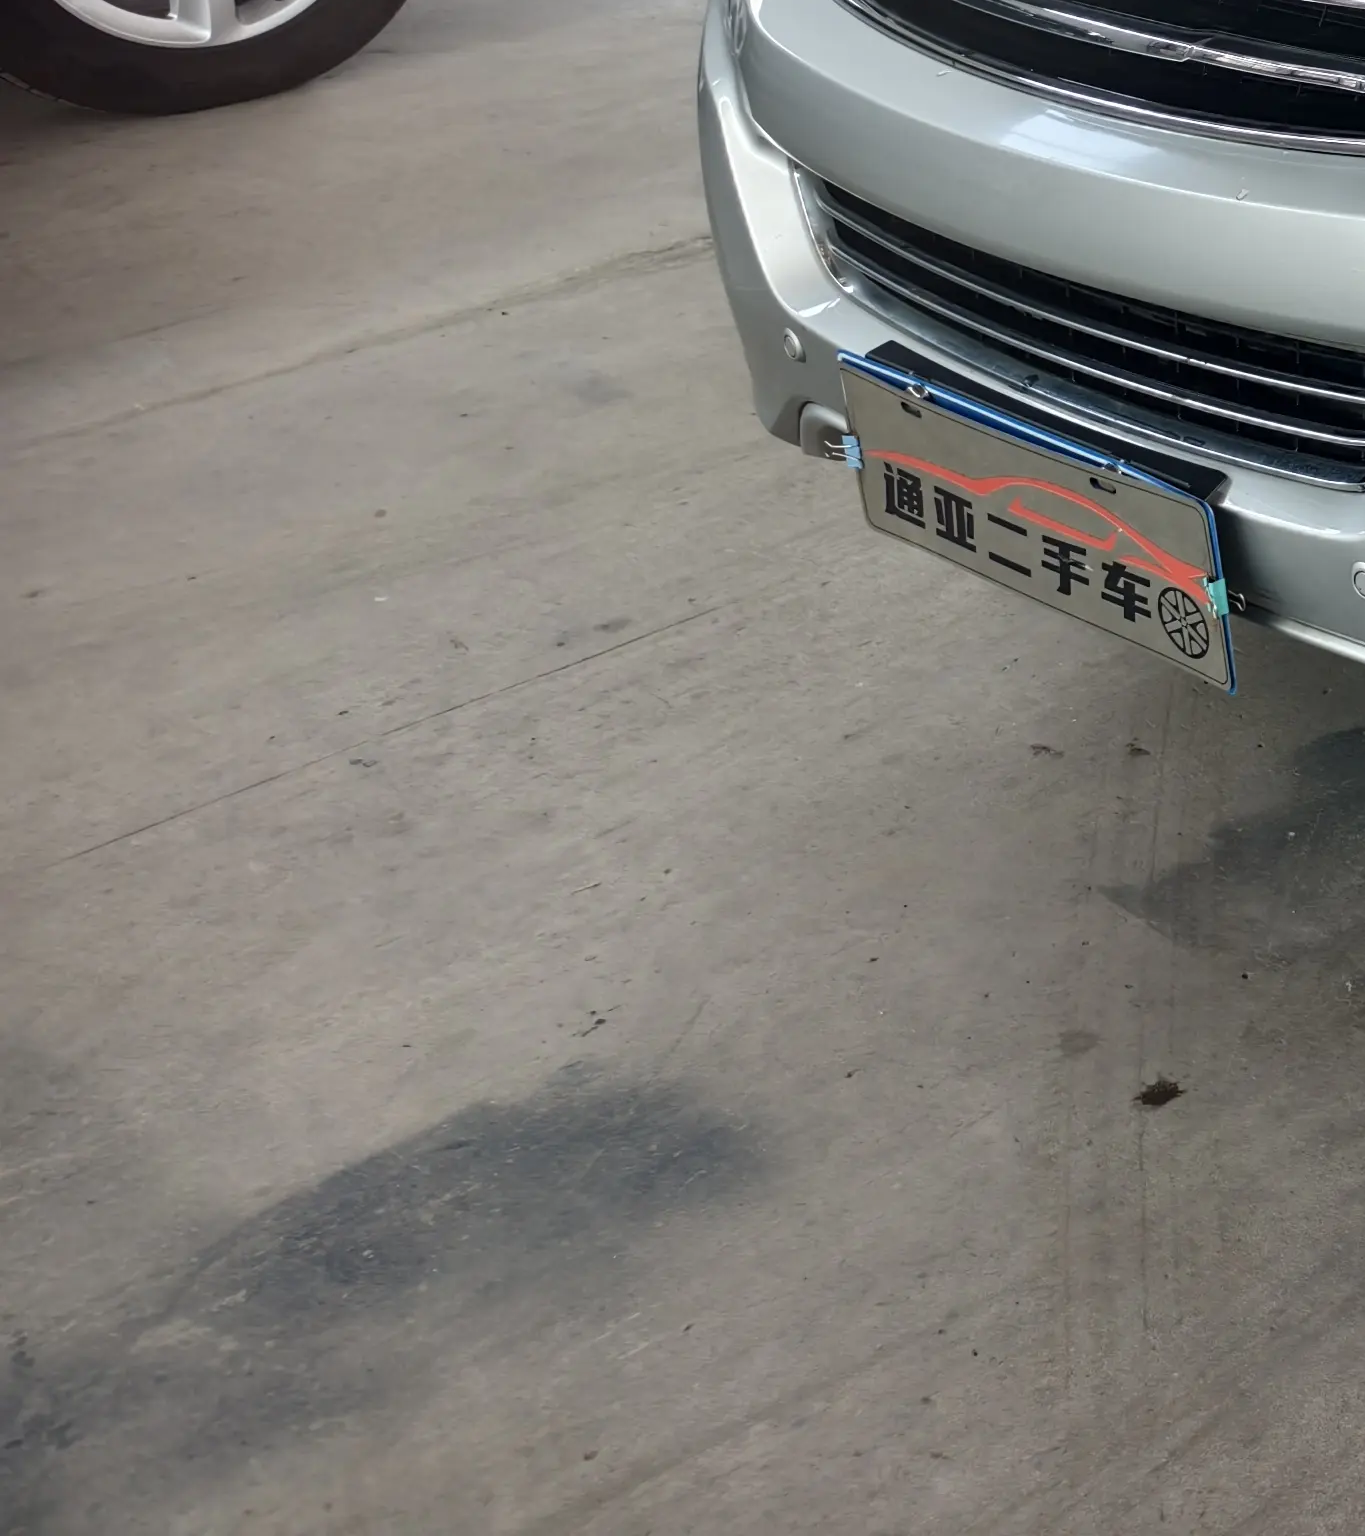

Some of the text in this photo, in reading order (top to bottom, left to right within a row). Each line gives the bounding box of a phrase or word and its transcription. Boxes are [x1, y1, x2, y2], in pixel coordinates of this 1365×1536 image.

[884, 464, 1152, 622] 通亚二手车
